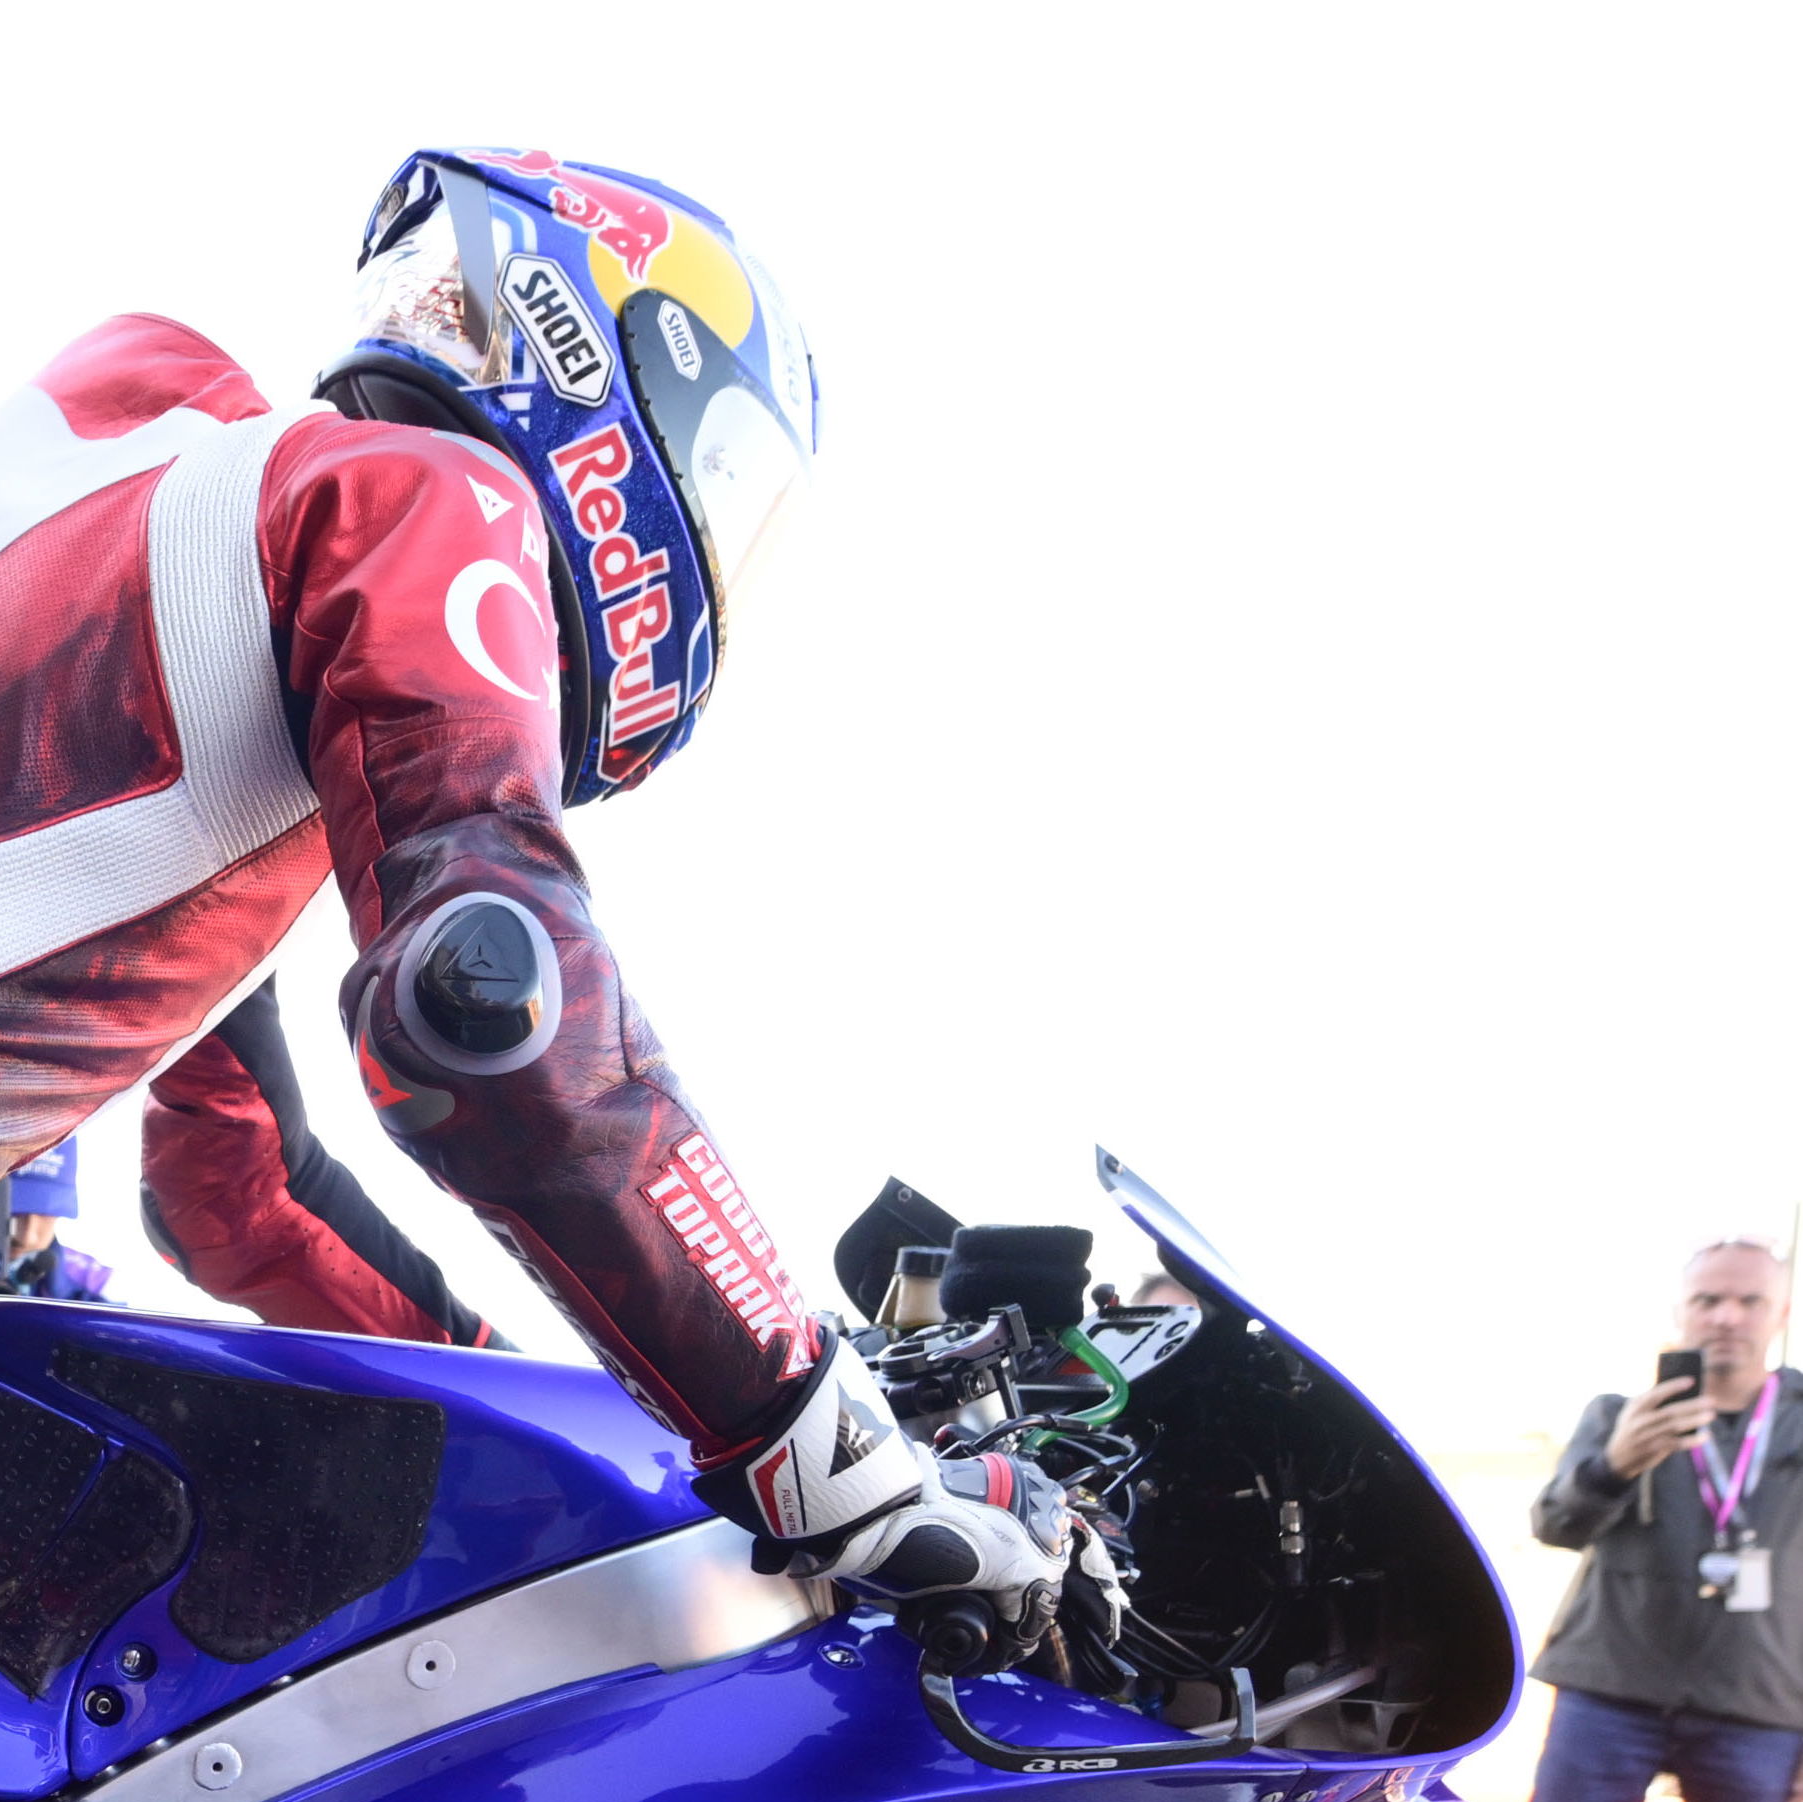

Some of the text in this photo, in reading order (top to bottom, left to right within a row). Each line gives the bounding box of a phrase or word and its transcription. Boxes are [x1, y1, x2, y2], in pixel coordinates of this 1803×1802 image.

[511, 269, 603, 387] SHOEI
[664, 311, 697, 369] SHOEI
[647, 1164, 795, 1346] TOPRAK
[676, 1134, 774, 1259] GOOD
[1059, 1758, 1118, 1770] RCB
